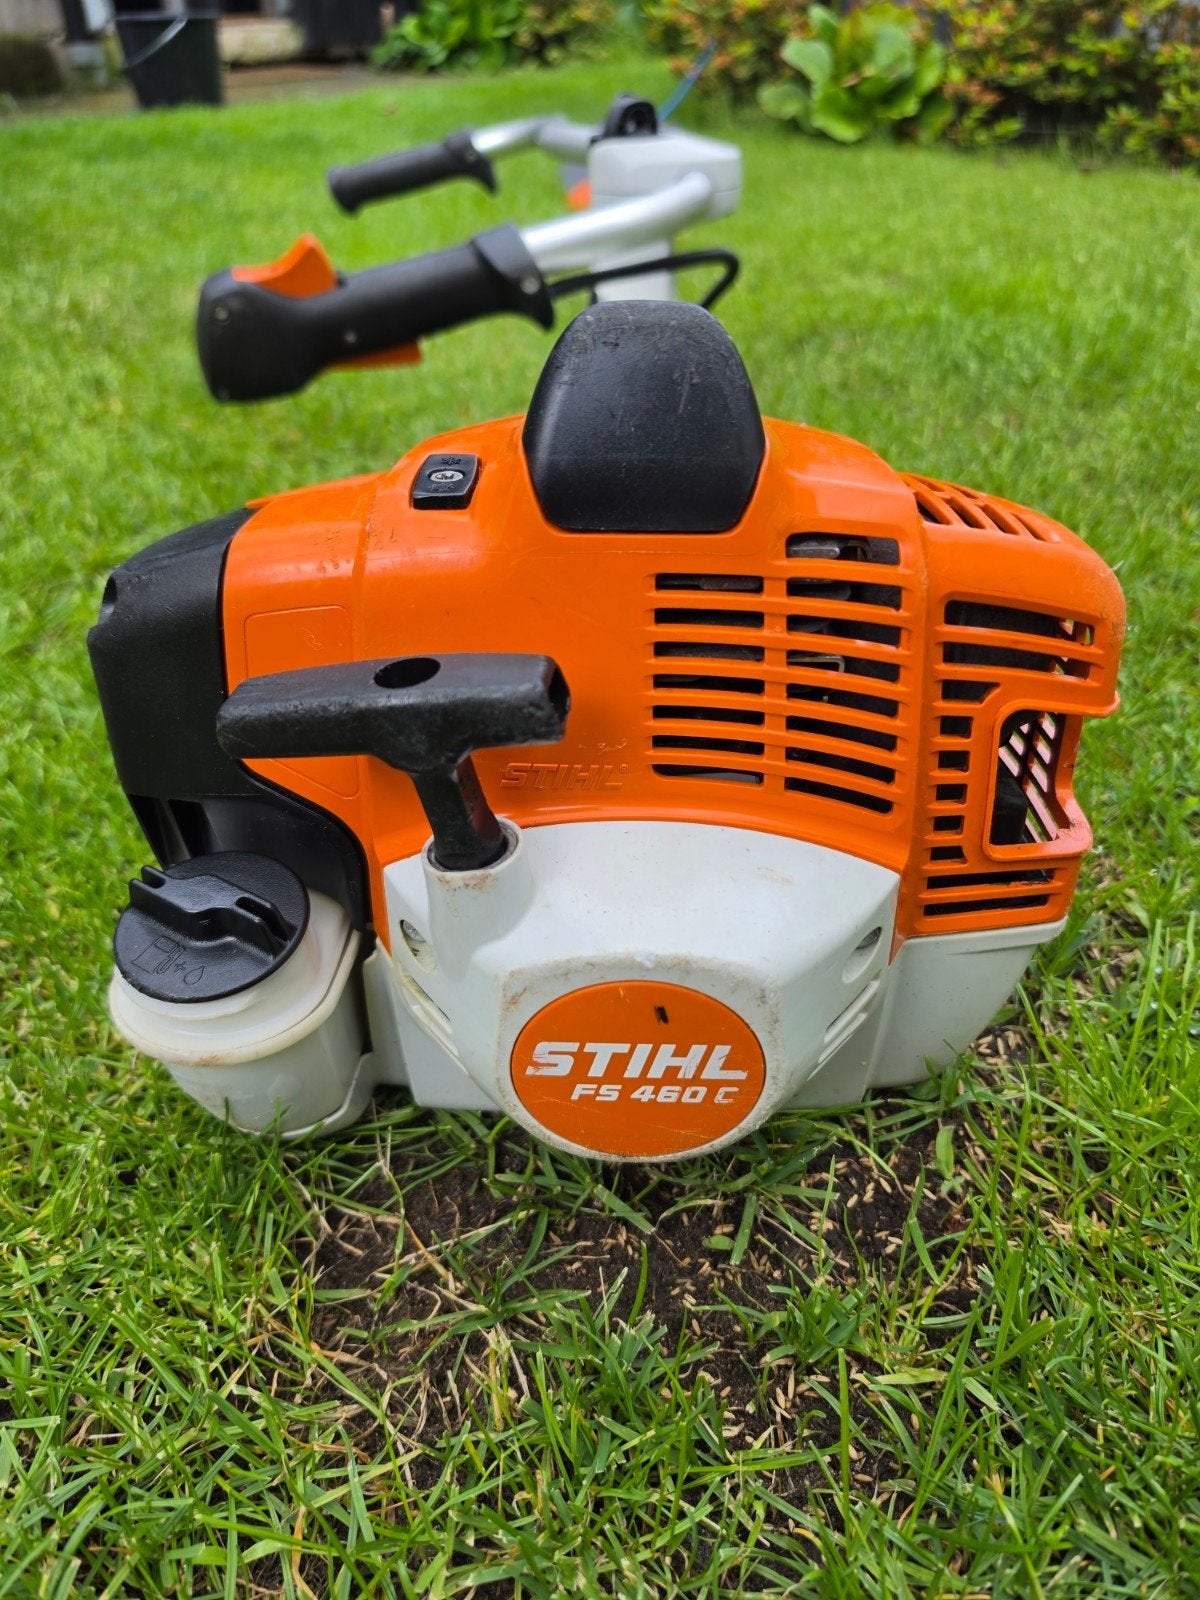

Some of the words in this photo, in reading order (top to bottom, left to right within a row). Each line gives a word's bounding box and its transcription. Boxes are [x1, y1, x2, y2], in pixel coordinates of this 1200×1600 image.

[525, 1041, 749, 1080] STIHL
[570, 1083, 622, 1102] FS
[630, 1085, 708, 1104] 460
[713, 1086, 739, 1104] C
